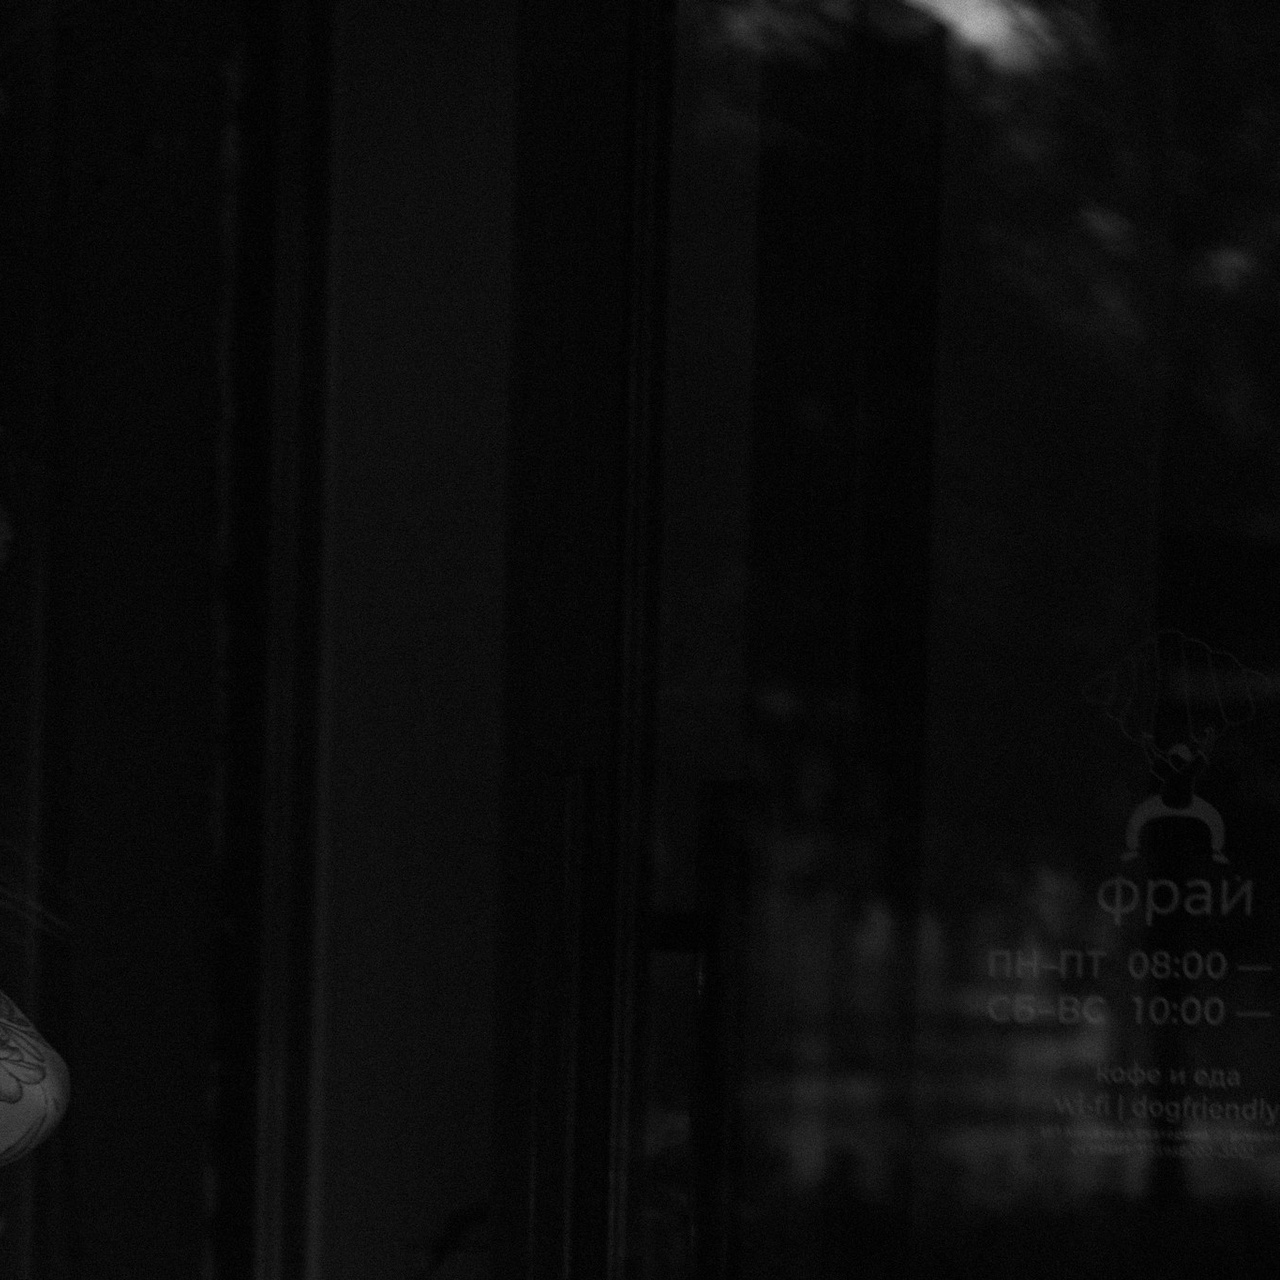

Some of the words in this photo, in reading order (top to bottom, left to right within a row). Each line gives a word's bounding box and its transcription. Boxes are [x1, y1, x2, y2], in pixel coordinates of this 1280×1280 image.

[1097, 875, 1253, 926] фрай
[1128, 950, 1227, 980] 08:00
[1132, 995, 1225, 1025] 10:00
[1096, 1061, 1161, 1087] кофе
[1170, 1067, 1186, 1085] и
[1194, 1067, 1241, 1090] еда
[1131, 1094, 1279, 1125] dogfriendly
